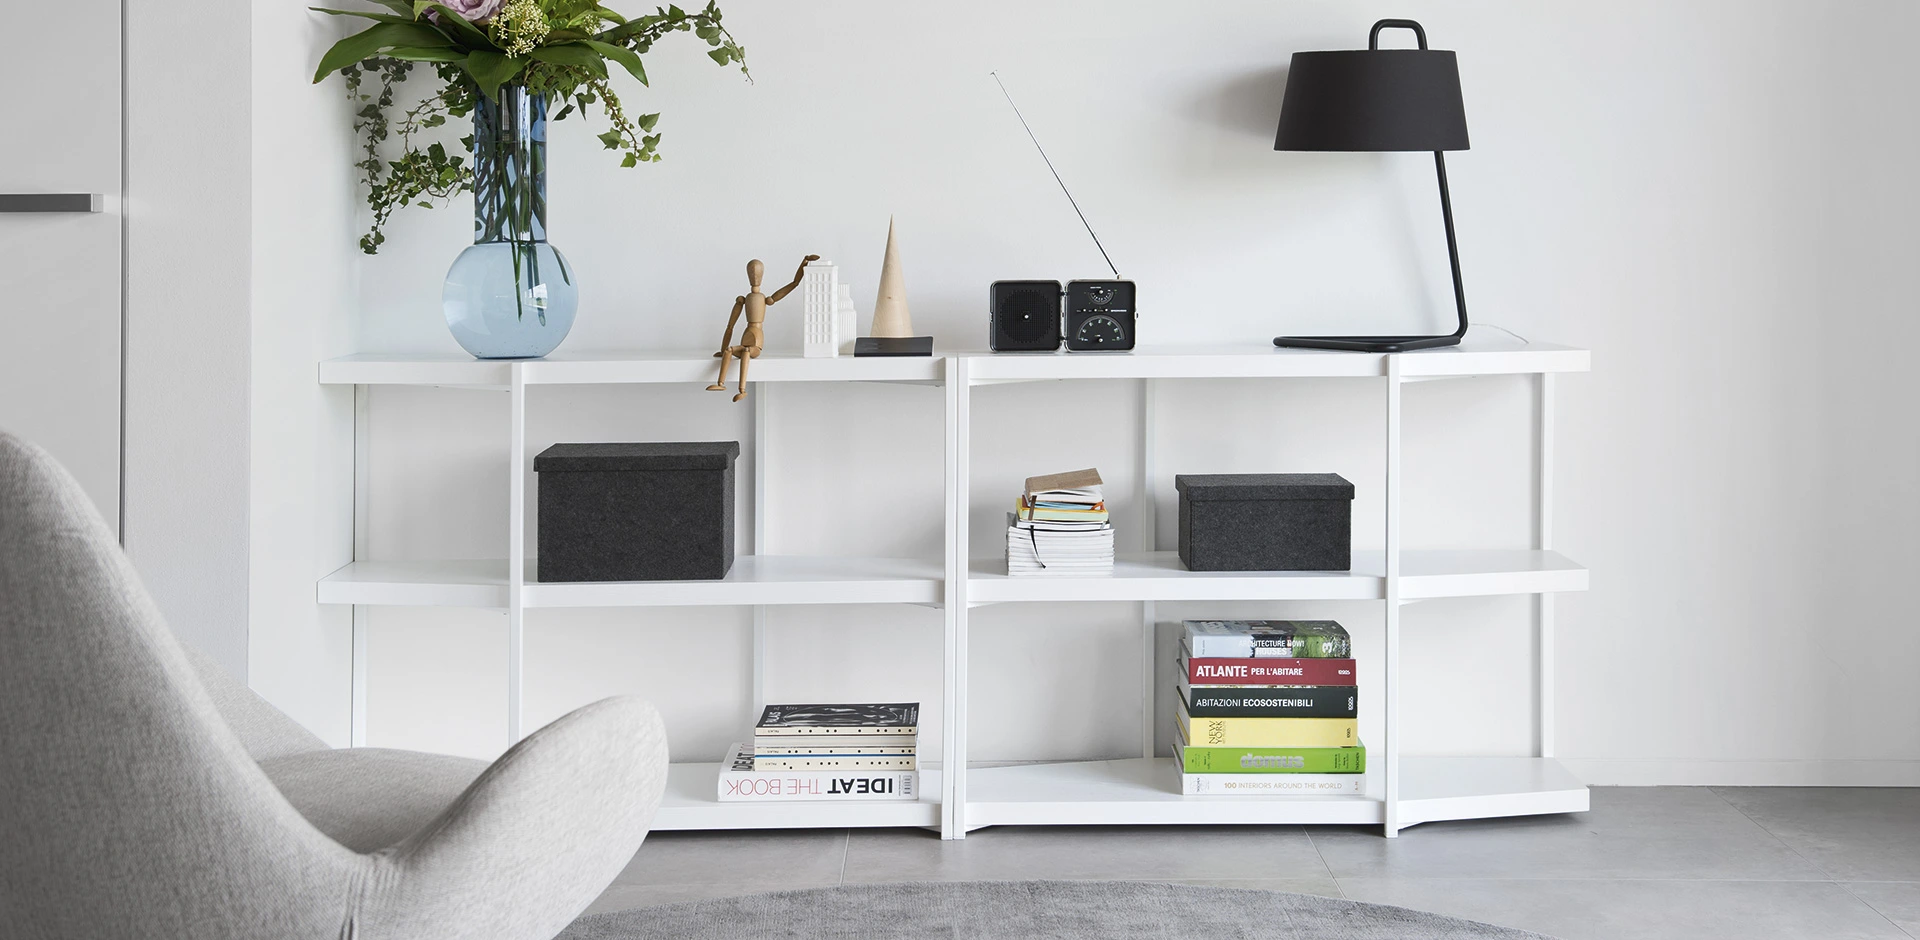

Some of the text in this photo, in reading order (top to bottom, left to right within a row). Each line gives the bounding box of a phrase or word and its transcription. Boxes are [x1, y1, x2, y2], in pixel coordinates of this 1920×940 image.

[1196, 665, 1303, 677] ATLANTE PER L'ABITARE
[1196, 698, 1313, 707] ABITAZIONI ECOSOSTENIBILI
[1208, 720, 1216, 744] NEW
[1215, 720, 1223, 744] YORK
[1240, 752, 1304, 769] domus
[726, 778, 781, 796] BOOK
[787, 778, 822, 795] THE
[827, 778, 893, 794] IDEAT
[1224, 781, 1237, 789] 100
